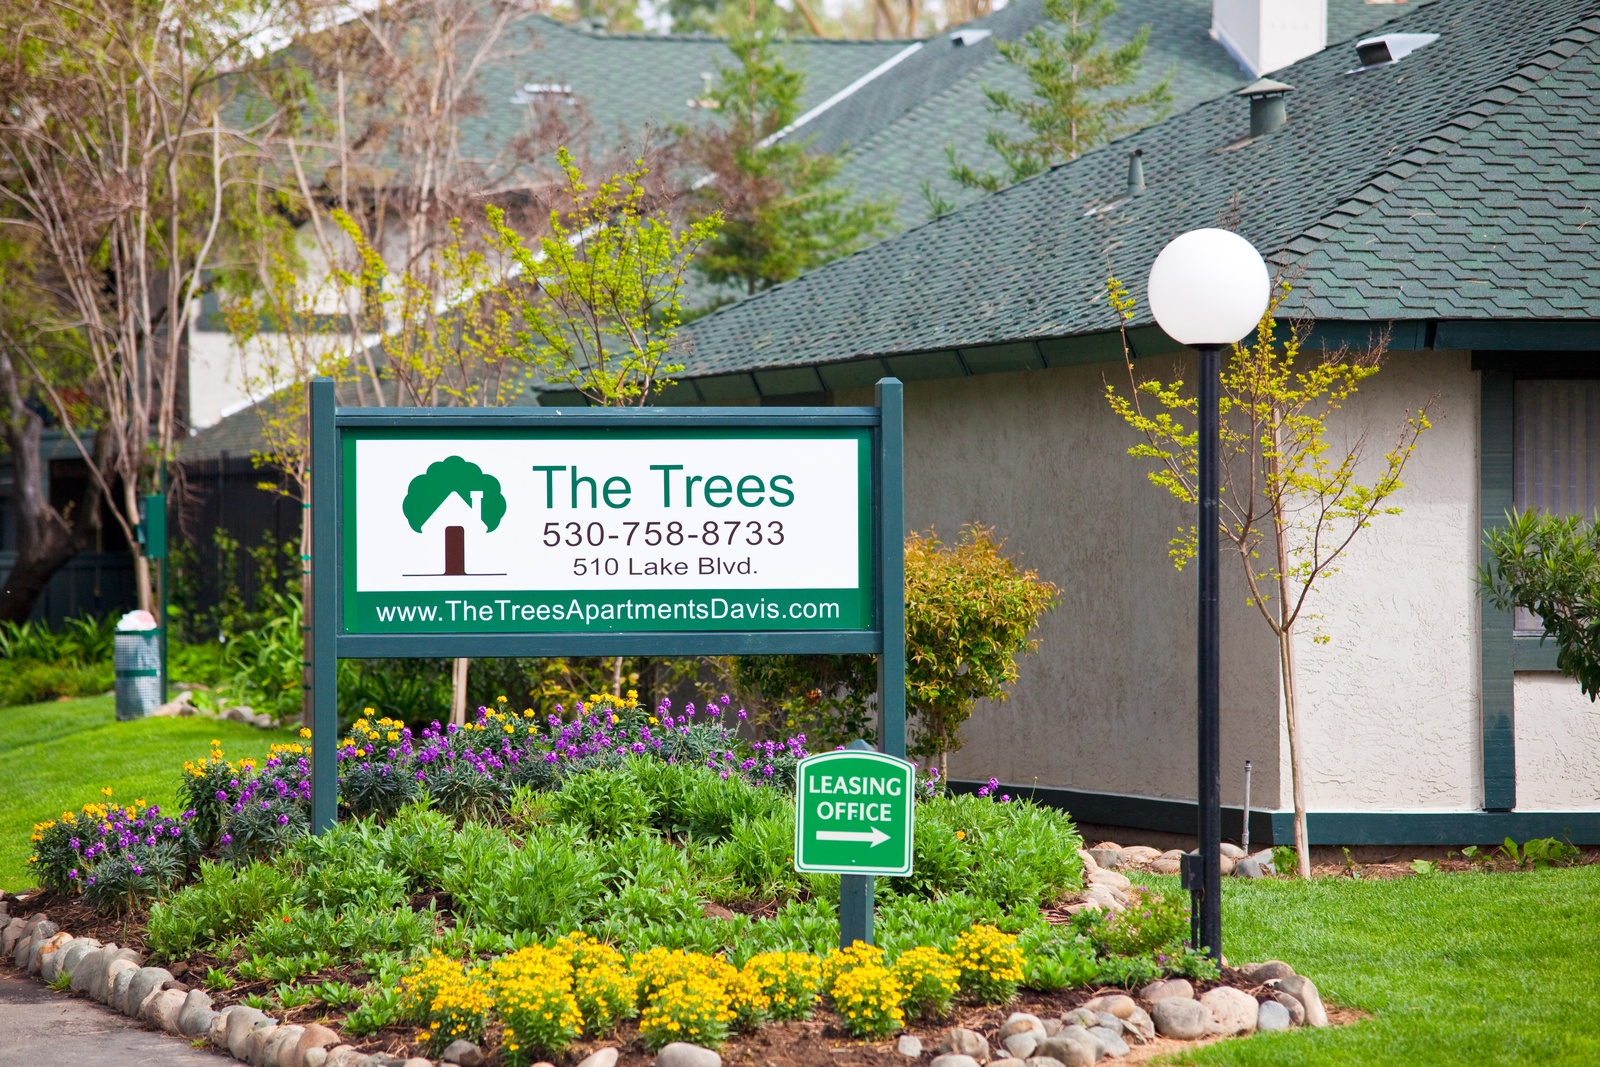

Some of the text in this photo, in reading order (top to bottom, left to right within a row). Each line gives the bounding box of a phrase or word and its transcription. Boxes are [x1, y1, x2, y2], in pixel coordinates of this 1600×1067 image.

[532, 464, 795, 509] The Trees
[543, 520, 785, 547] 530-758-8733
[573, 556, 758, 576] 510 Lake Blvd.
[376, 597, 840, 625] www.TheTreesApartmentsDavis.com
[809, 775, 901, 797] LEASING
[816, 801, 892, 822] OFFICE
